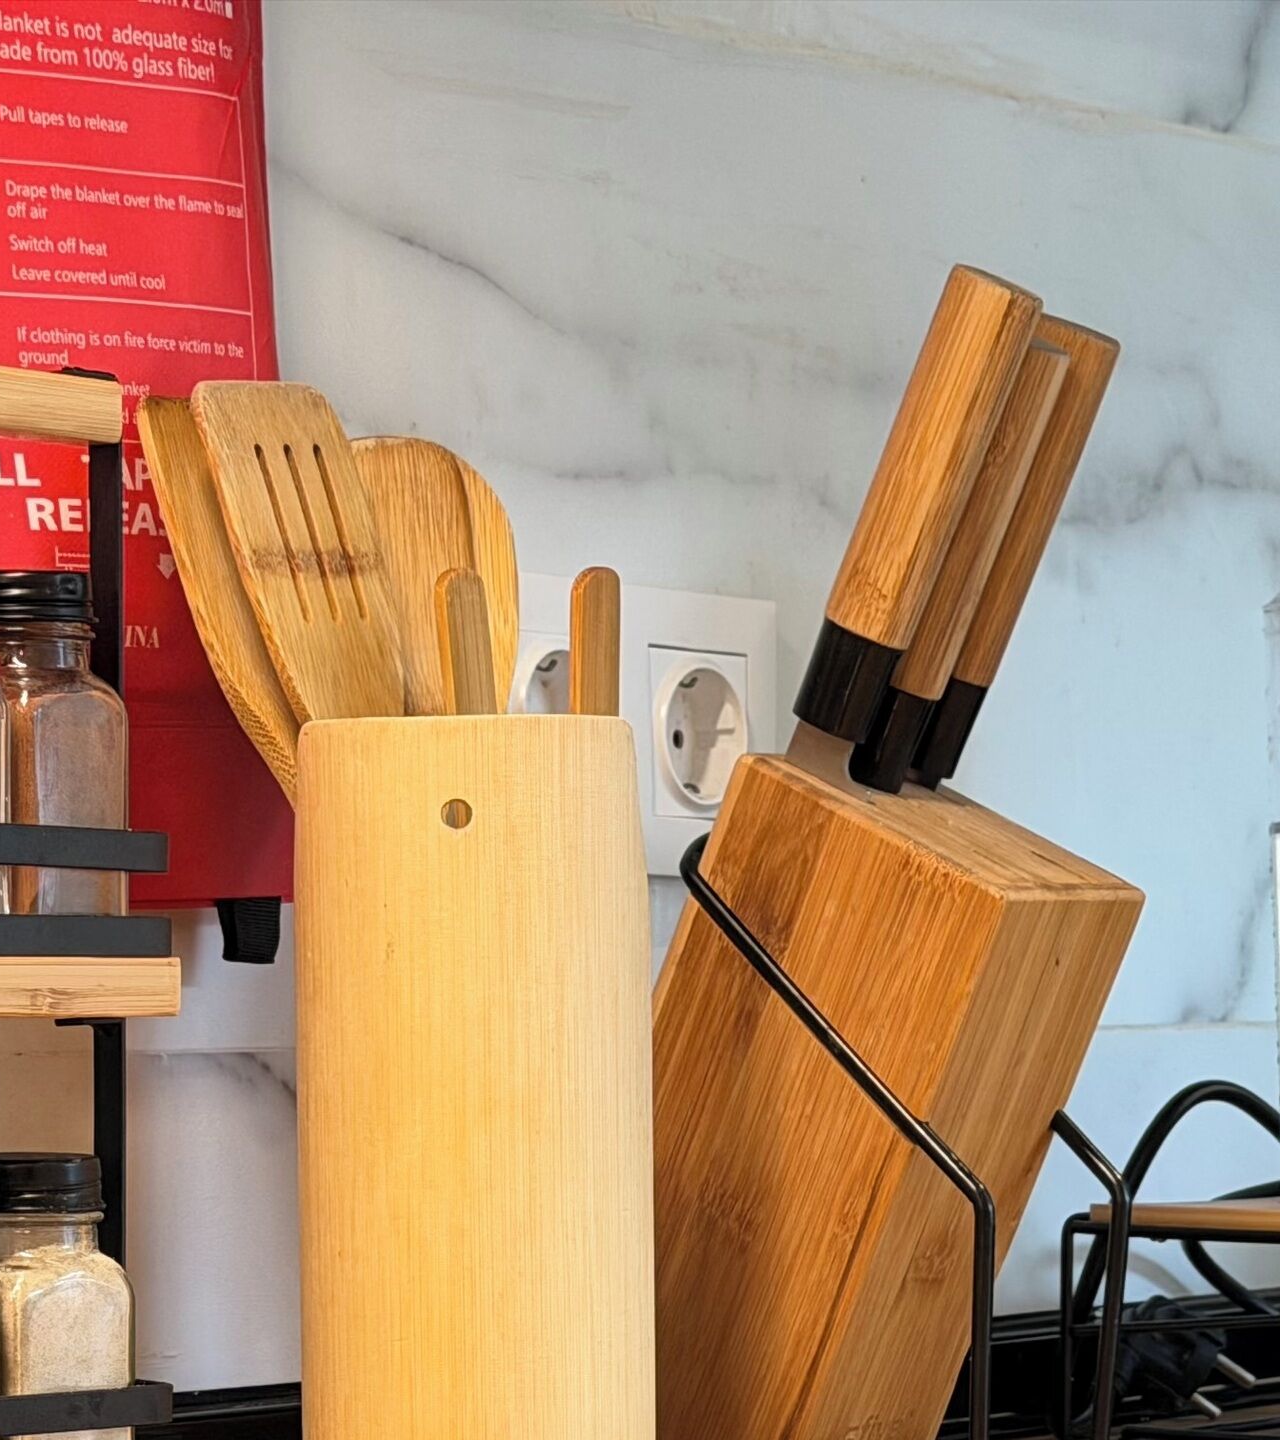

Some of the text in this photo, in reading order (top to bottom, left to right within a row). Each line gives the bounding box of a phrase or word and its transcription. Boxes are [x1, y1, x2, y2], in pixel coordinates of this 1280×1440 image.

[55, 16, 69, 37] is
[74, 23, 103, 42] not
[112, 24, 187, 52] adequate
[191, 33, 216, 57] size
[219, 38, 233, 61] for
[36, 42, 78, 66] from
[83, 47, 128, 72] 100%
[132, 54, 174, 79] glass
[177, 57, 215, 83] fiber!
[0, 104, 128, 134] Pull tapes to release
[5, 179, 243, 219] Drape the blanket over the flame to seal
[7, 202, 47, 220] off air
[9, 233, 107, 257] Switch off heat
[12, 263, 166, 291] Leave covered until cool
[16, 326, 244, 359] If clothing is on fire force victim to the
[19, 350, 69, 368] ground
